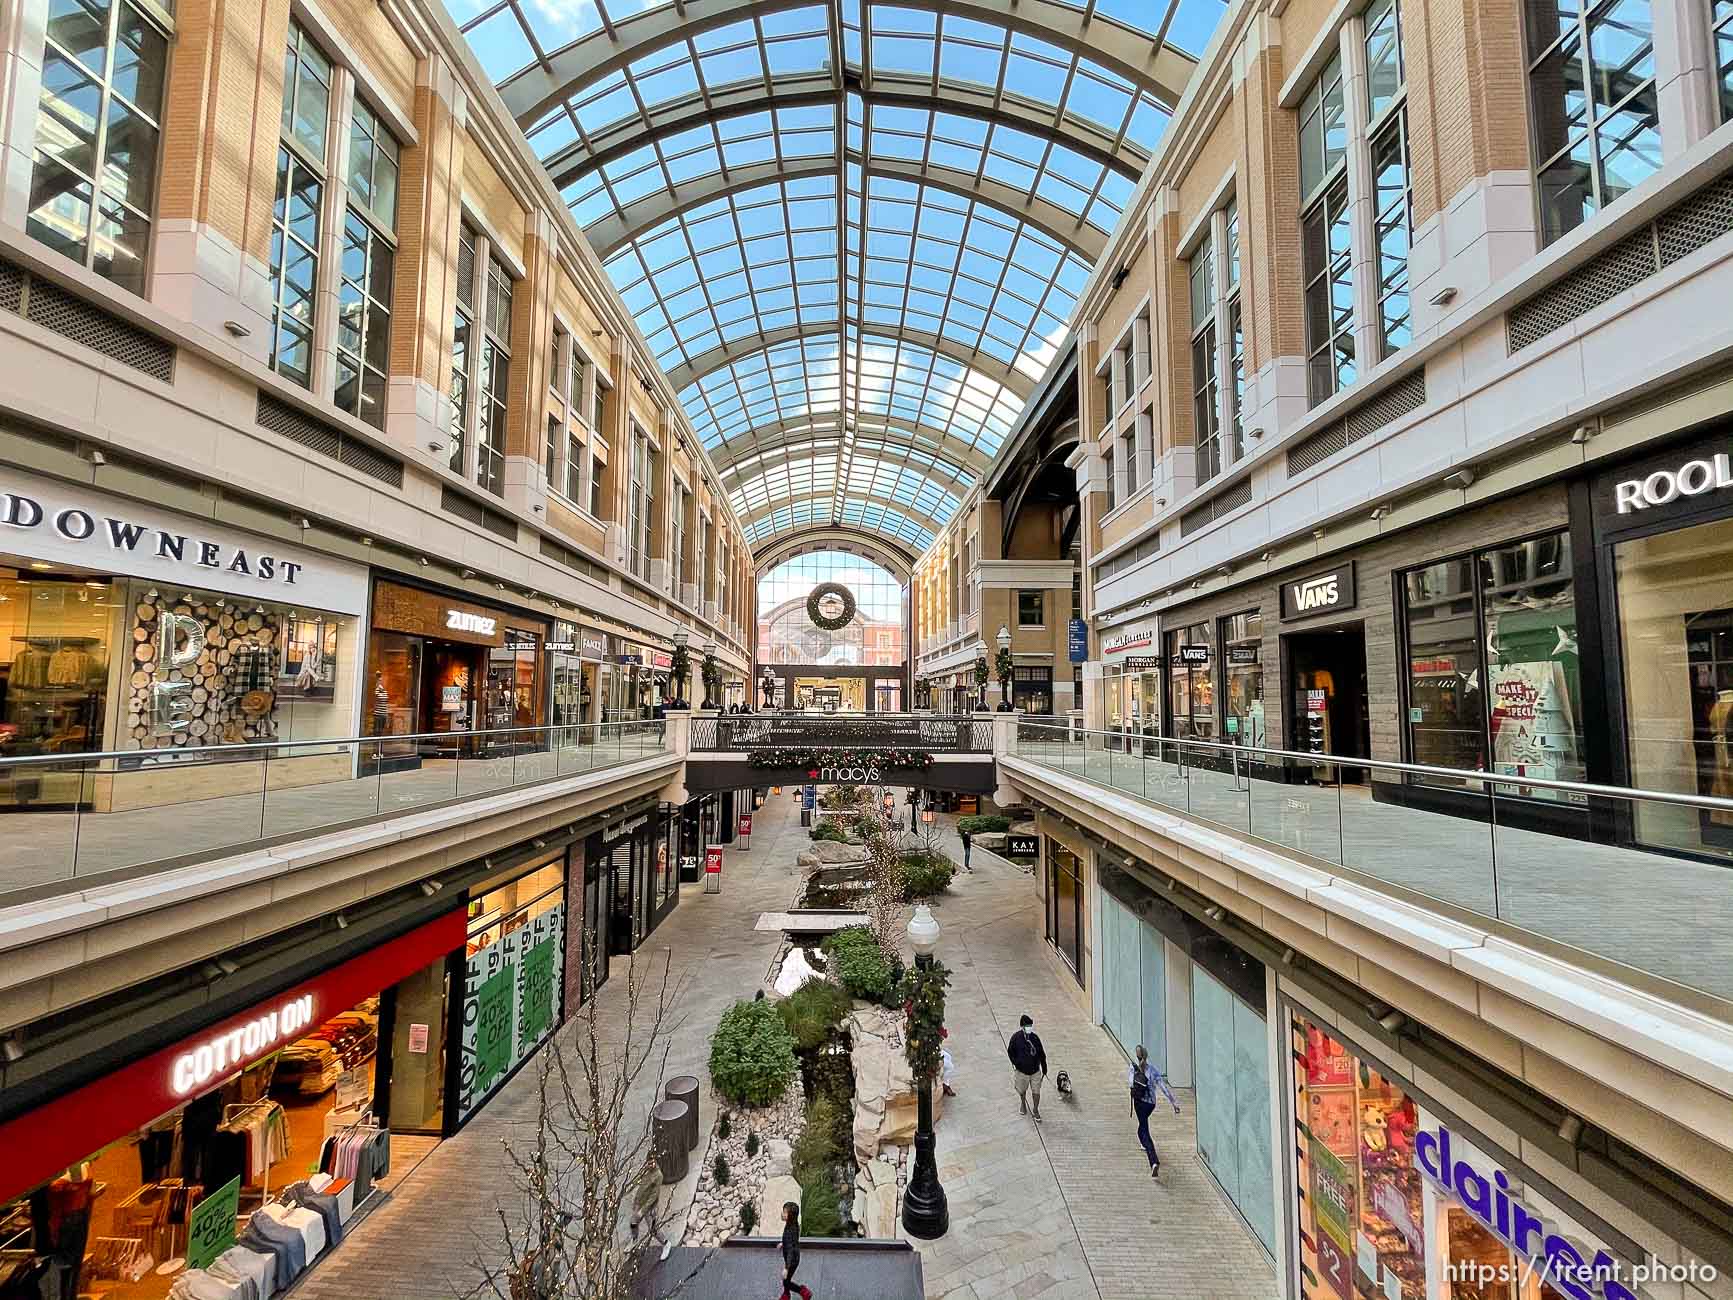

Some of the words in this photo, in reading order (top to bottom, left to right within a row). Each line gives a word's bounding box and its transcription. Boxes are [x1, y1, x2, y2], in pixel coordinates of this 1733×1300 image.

[0, 493, 302, 584] DOWNEAST
[1293, 574, 1339, 611] VANS
[1182, 649, 1207, 660] VANS
[1498, 685, 1522, 694] MAKE
[463, 960, 481, 1028] OFF
[532, 986, 550, 1008] OFF
[480, 998, 506, 1028] 40%
[488, 1011, 511, 1044] OFF
[173, 1011, 279, 1094] COTTON
[281, 994, 313, 1035] ON
[1316, 1171, 1346, 1213] FREE
[191, 1206, 226, 1241] 40%
[203, 1213, 235, 1247] OFF
